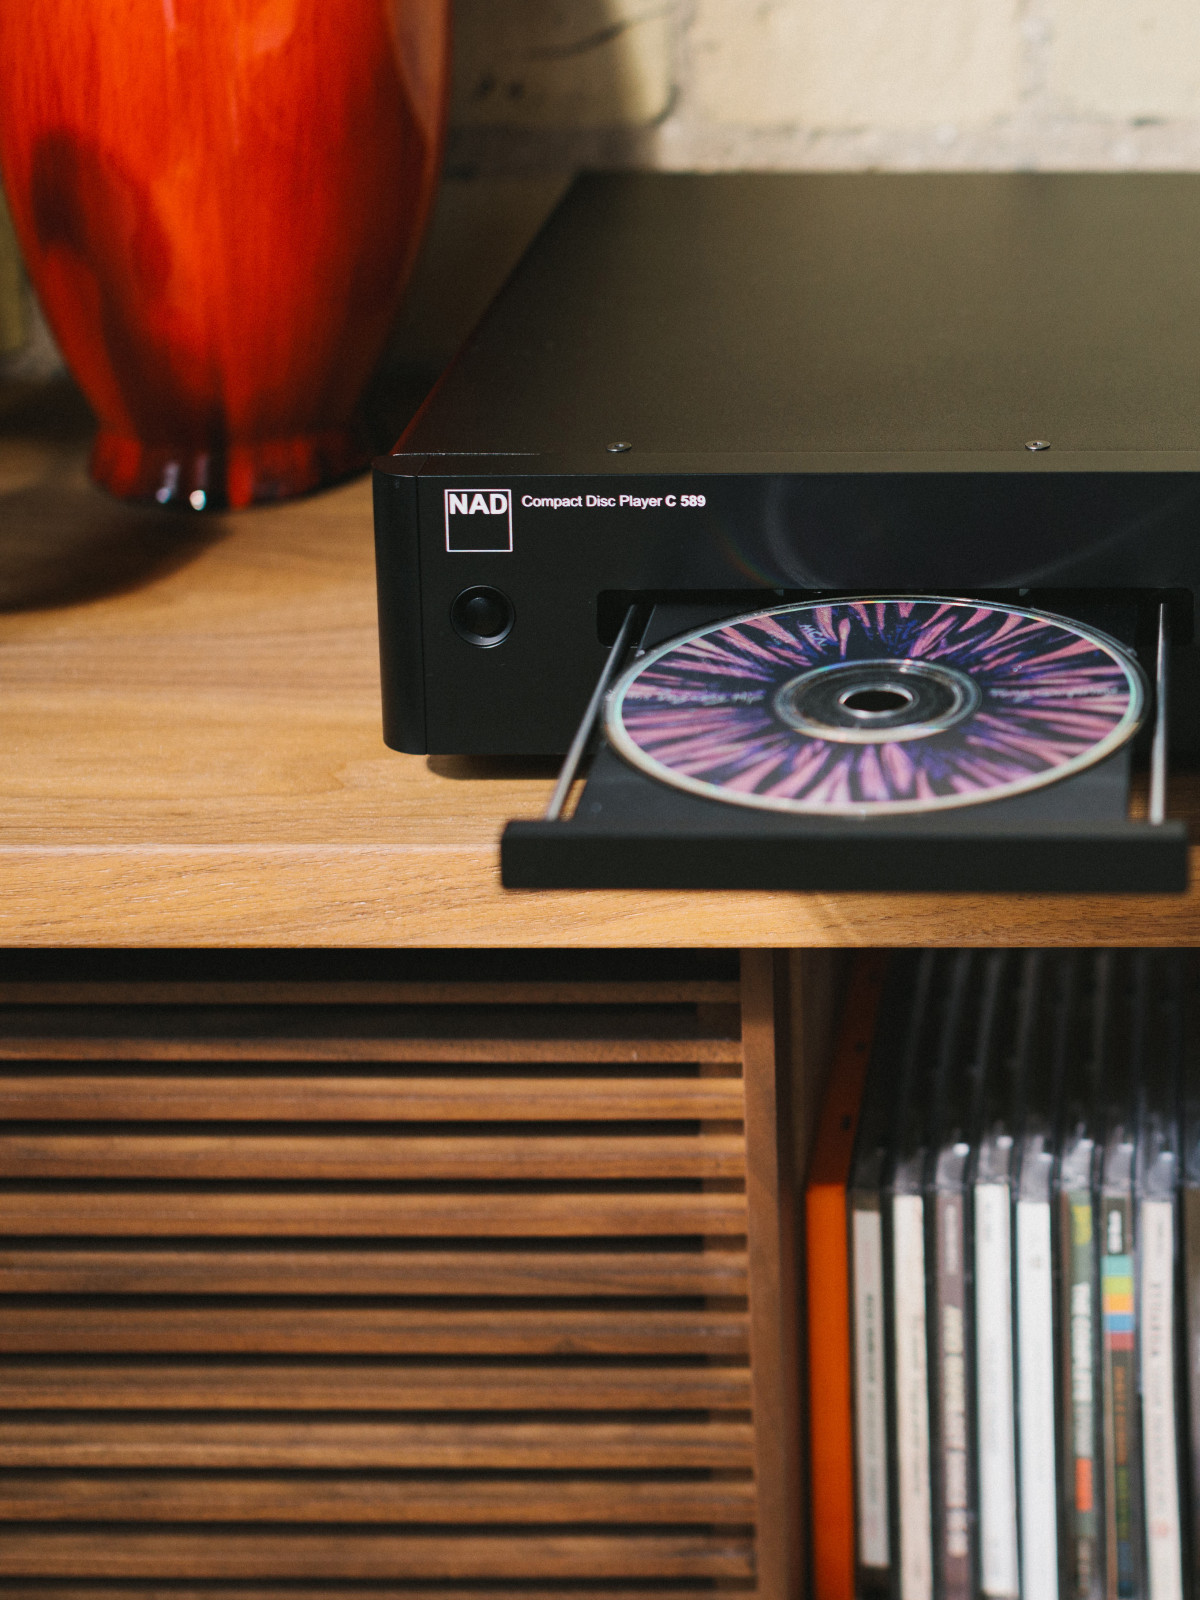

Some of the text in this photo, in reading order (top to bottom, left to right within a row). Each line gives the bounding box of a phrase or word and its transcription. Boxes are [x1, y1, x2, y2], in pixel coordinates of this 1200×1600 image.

[448, 493, 508, 515] NAD
[521, 495, 706, 509] Compact Disc Player C 589
